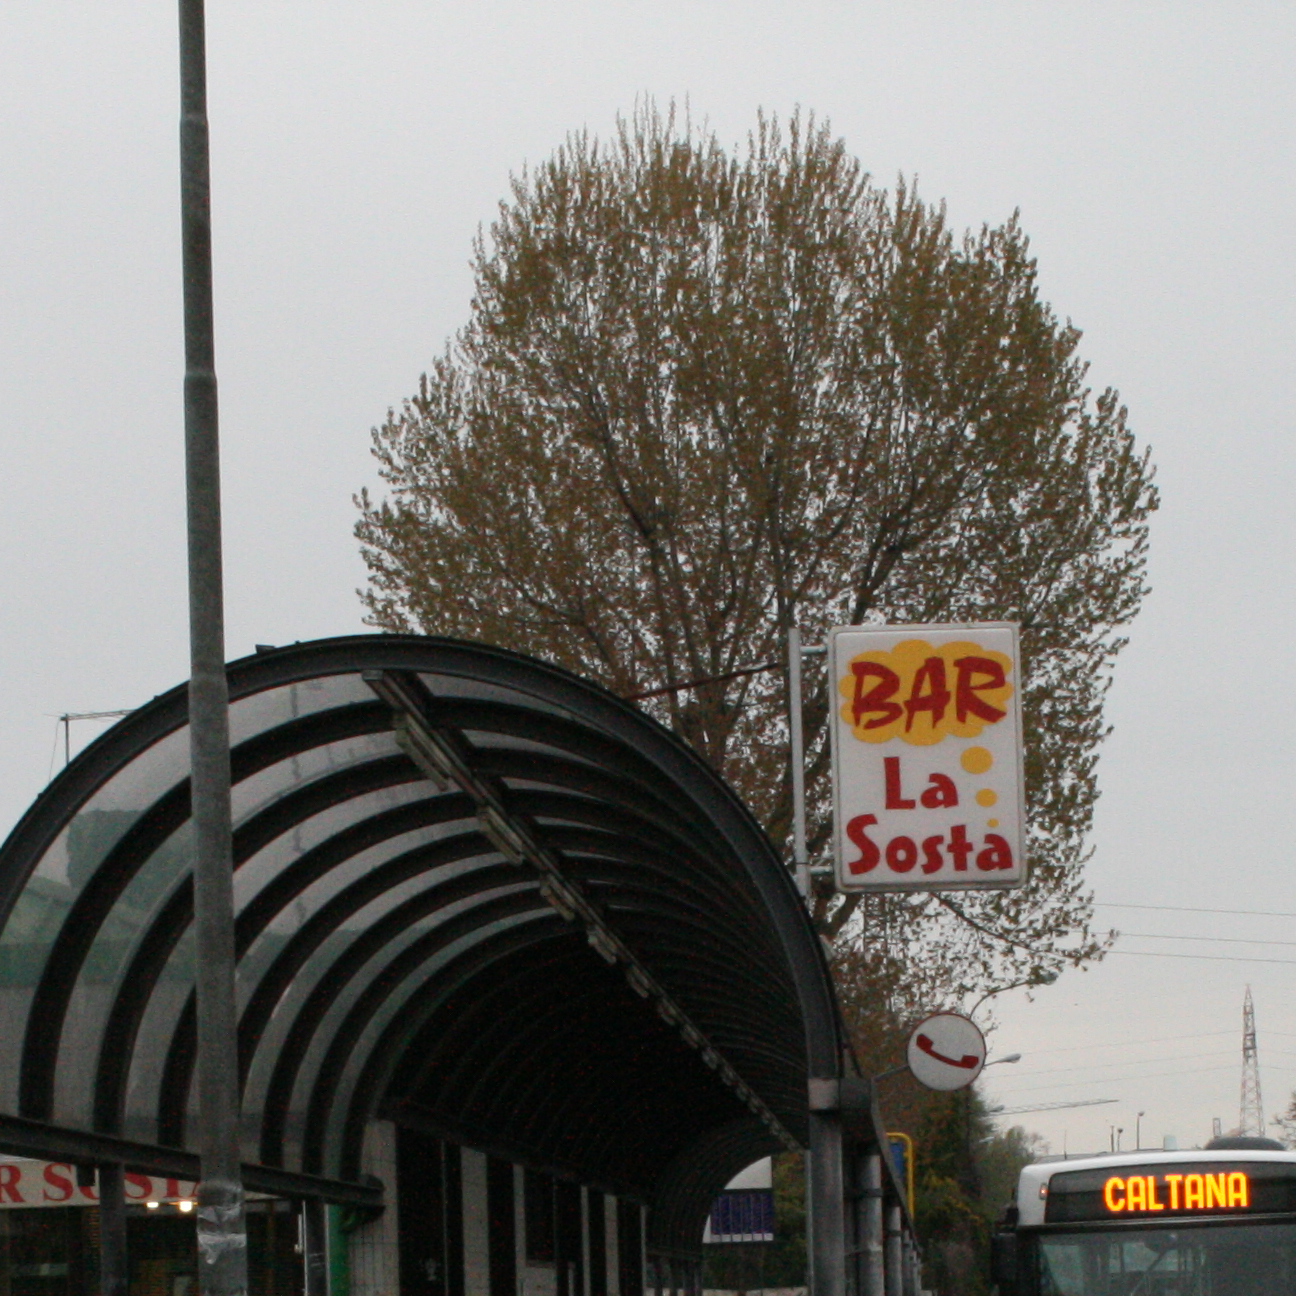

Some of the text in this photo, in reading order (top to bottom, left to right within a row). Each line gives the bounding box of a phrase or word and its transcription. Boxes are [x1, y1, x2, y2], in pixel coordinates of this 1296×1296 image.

[851, 656, 1006, 733] BAR
[883, 756, 959, 810] La
[846, 813, 1013, 875] Sosta
[1105, 1172, 1249, 1212] CALTANA
